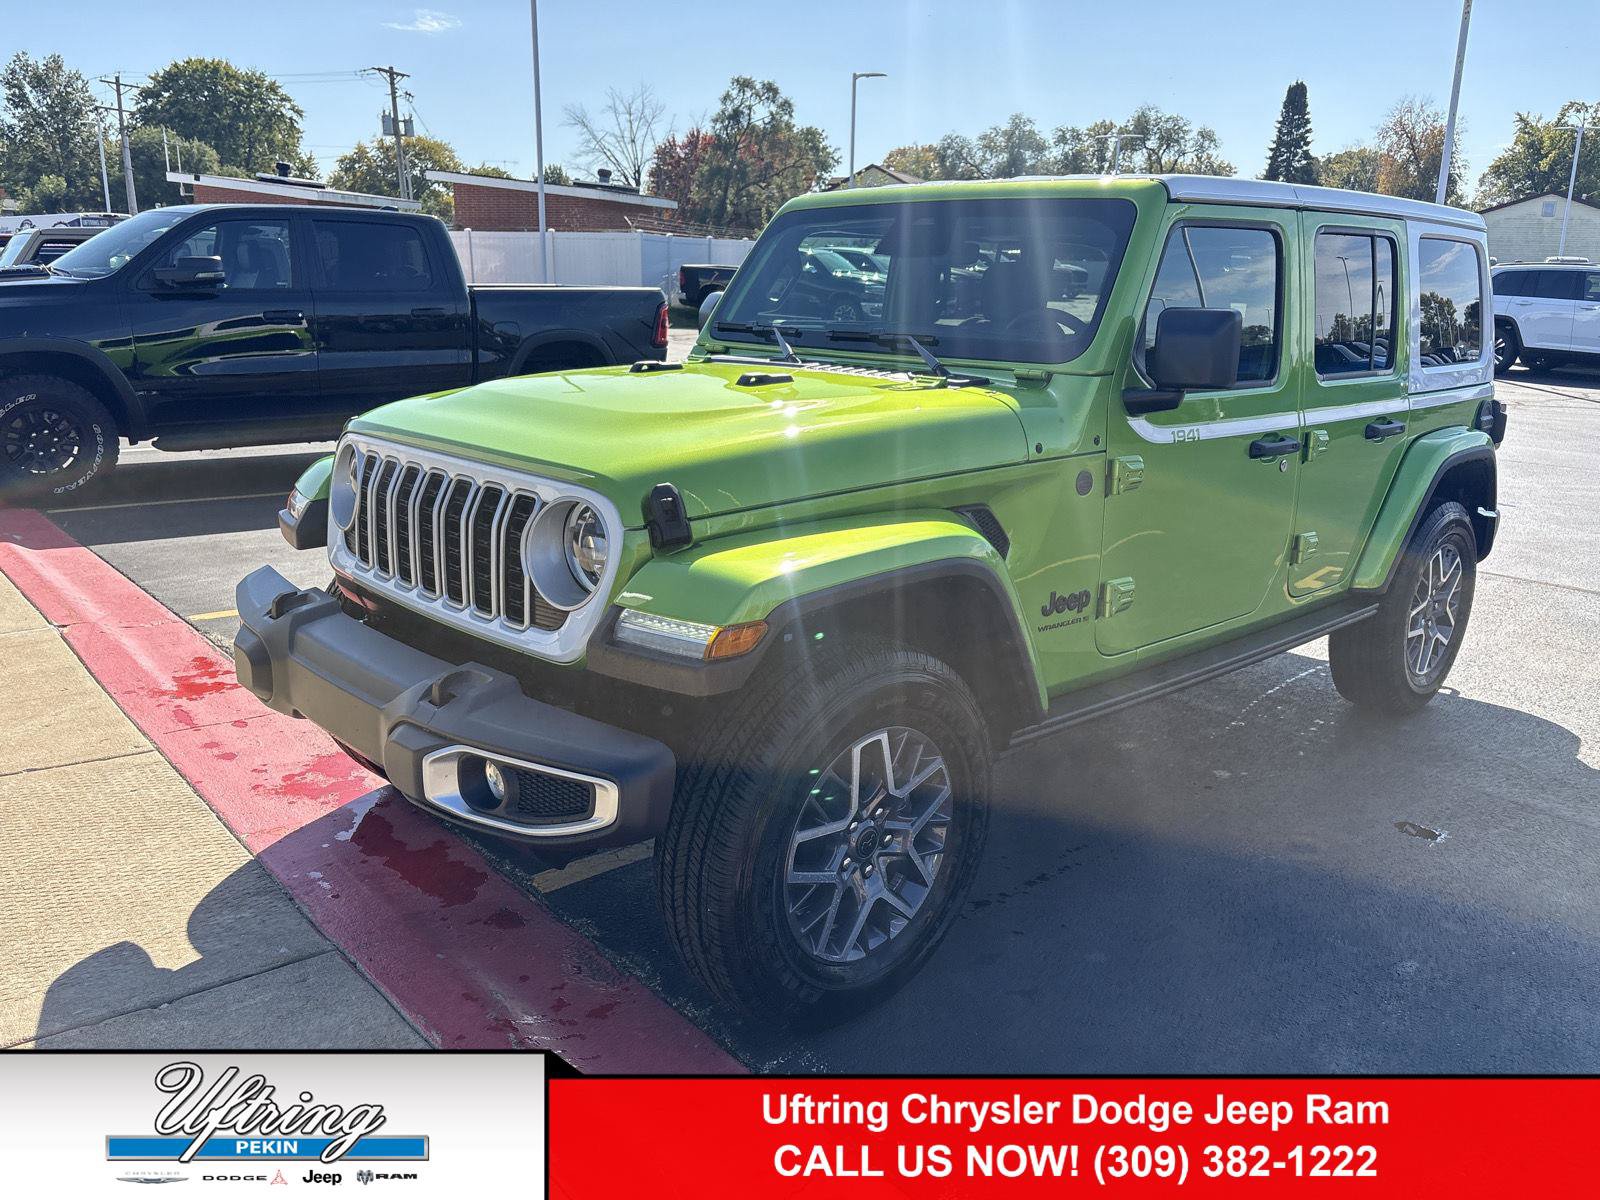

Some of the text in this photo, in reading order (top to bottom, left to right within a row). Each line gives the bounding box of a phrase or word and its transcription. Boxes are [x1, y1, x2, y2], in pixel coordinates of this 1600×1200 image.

[1171, 428, 1200, 443] 1941
[53, 423, 104, 493] GOODYEAR
[1041, 590, 1091, 616] Jeep
[1037, 617, 1082, 632] WRANGLER
